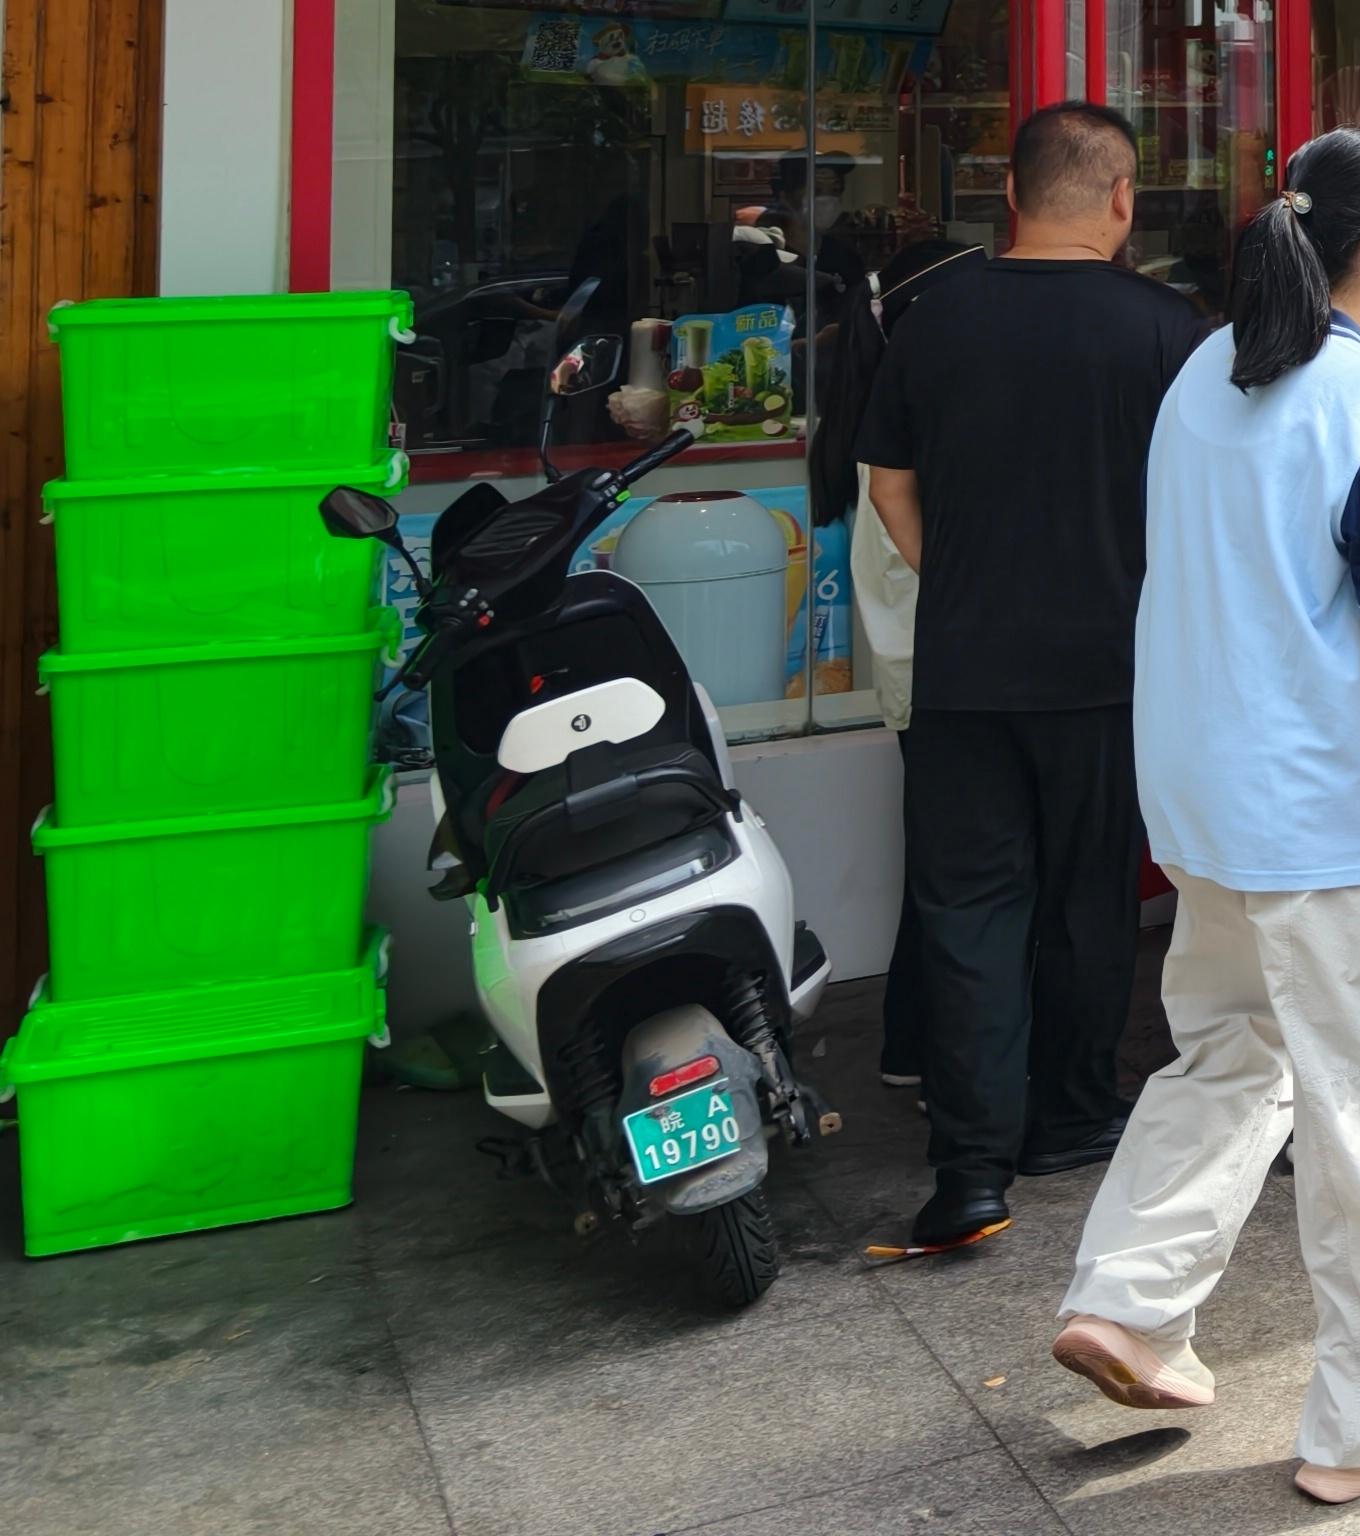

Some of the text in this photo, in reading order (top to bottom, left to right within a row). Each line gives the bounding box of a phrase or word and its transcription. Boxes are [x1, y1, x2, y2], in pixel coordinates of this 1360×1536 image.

[659, 1094, 729, 1134] 皖 A
[644, 1116, 741, 1170] 19790
